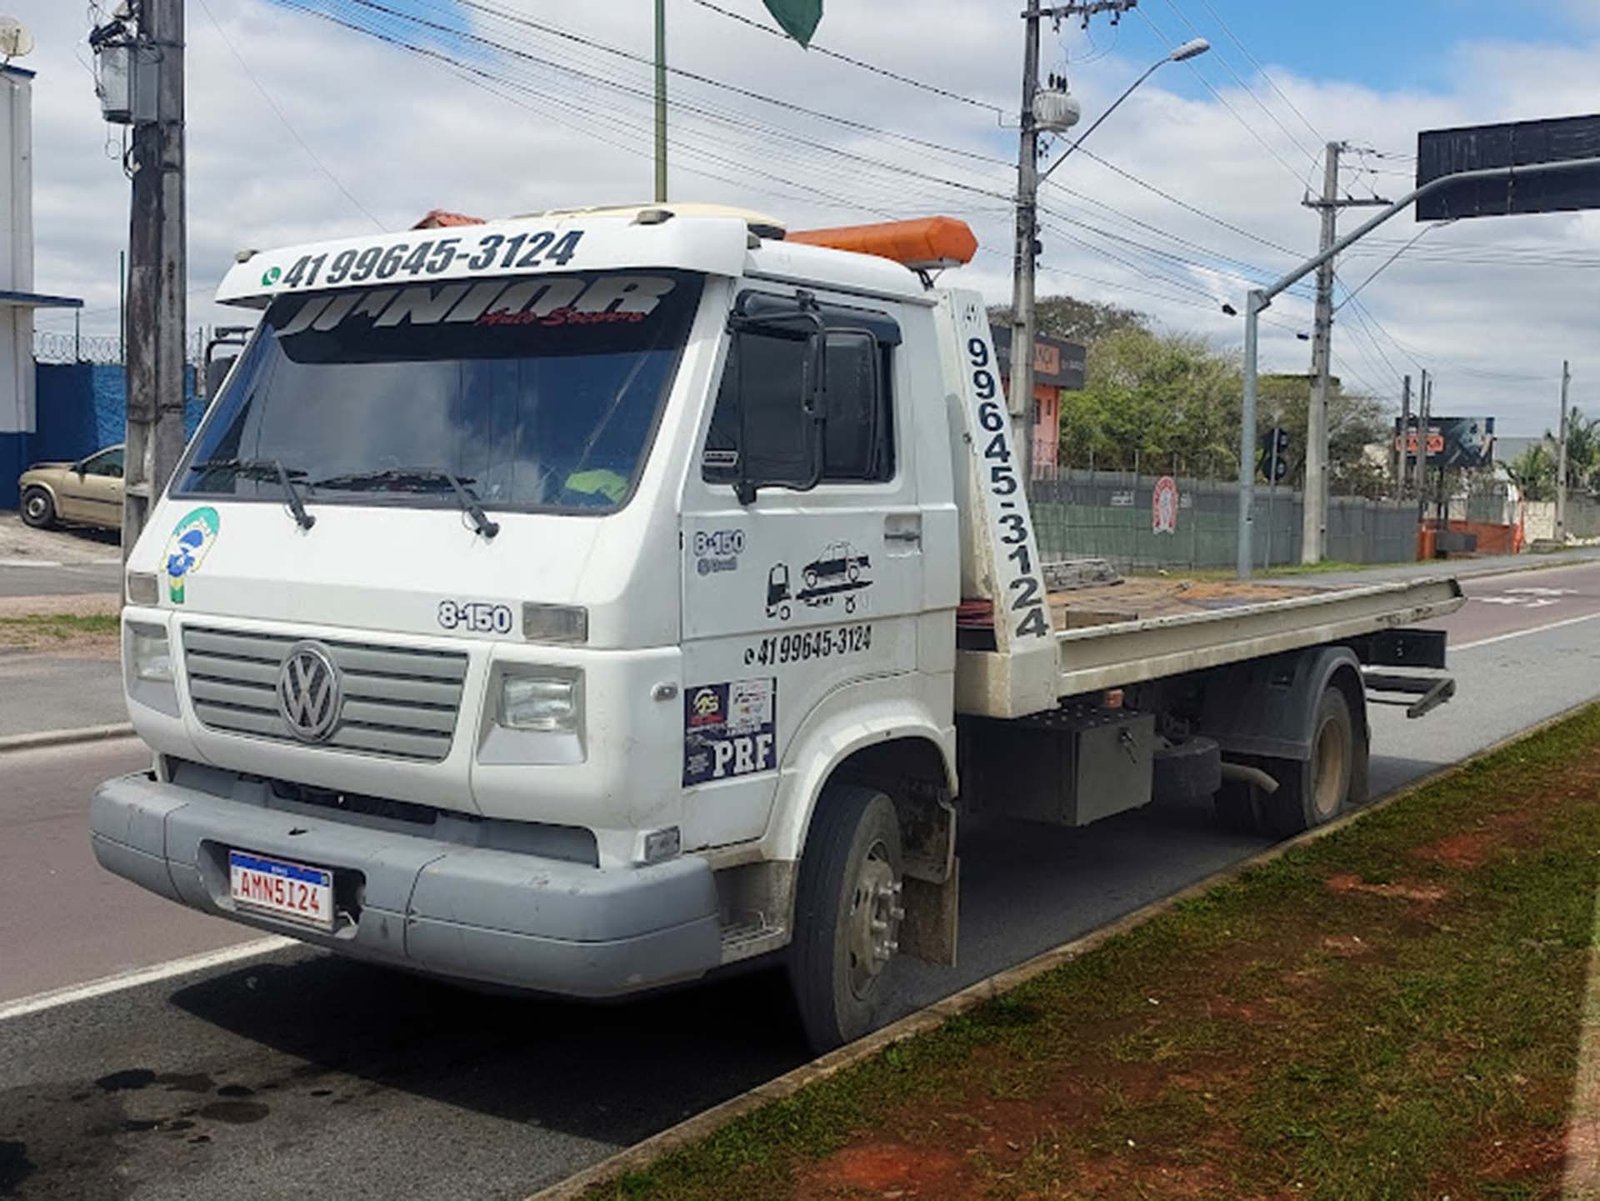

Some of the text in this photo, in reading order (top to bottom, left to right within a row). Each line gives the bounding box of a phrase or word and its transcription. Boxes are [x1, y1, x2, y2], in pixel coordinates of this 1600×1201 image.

[283, 230, 585, 288] 41 99645-3124
[967, 337, 1049, 640] 99645-3124
[758, 624, 872, 665] 41 99645-3124
[713, 733, 773, 778] PRF
